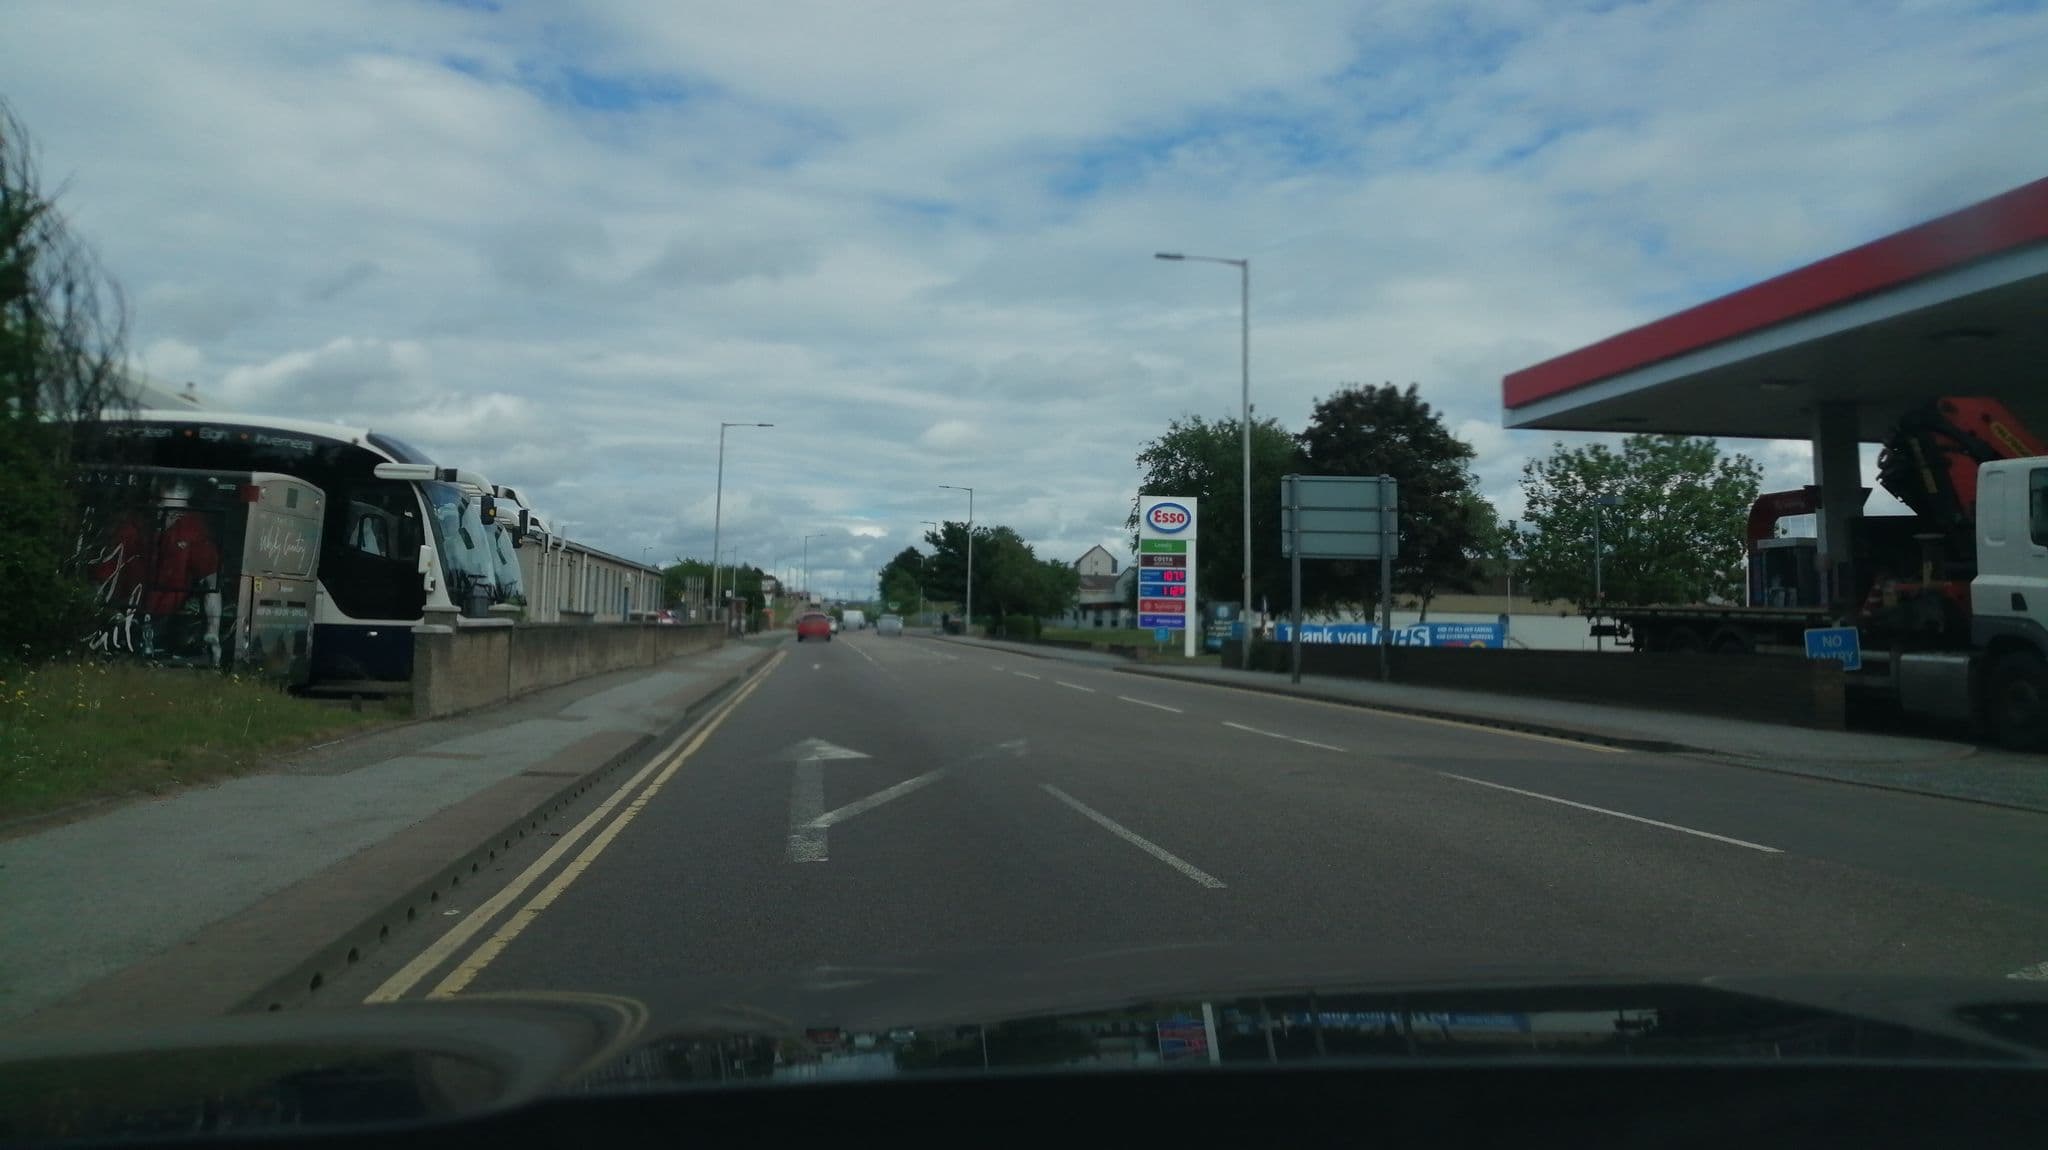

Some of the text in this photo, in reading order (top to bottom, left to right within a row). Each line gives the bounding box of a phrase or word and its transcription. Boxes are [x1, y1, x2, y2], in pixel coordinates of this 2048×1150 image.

[1154, 510, 1185, 523] Esso
[1285, 627, 1332, 643] Tank
[1337, 631, 1367, 644] you
[1822, 634, 1842, 648] NO
